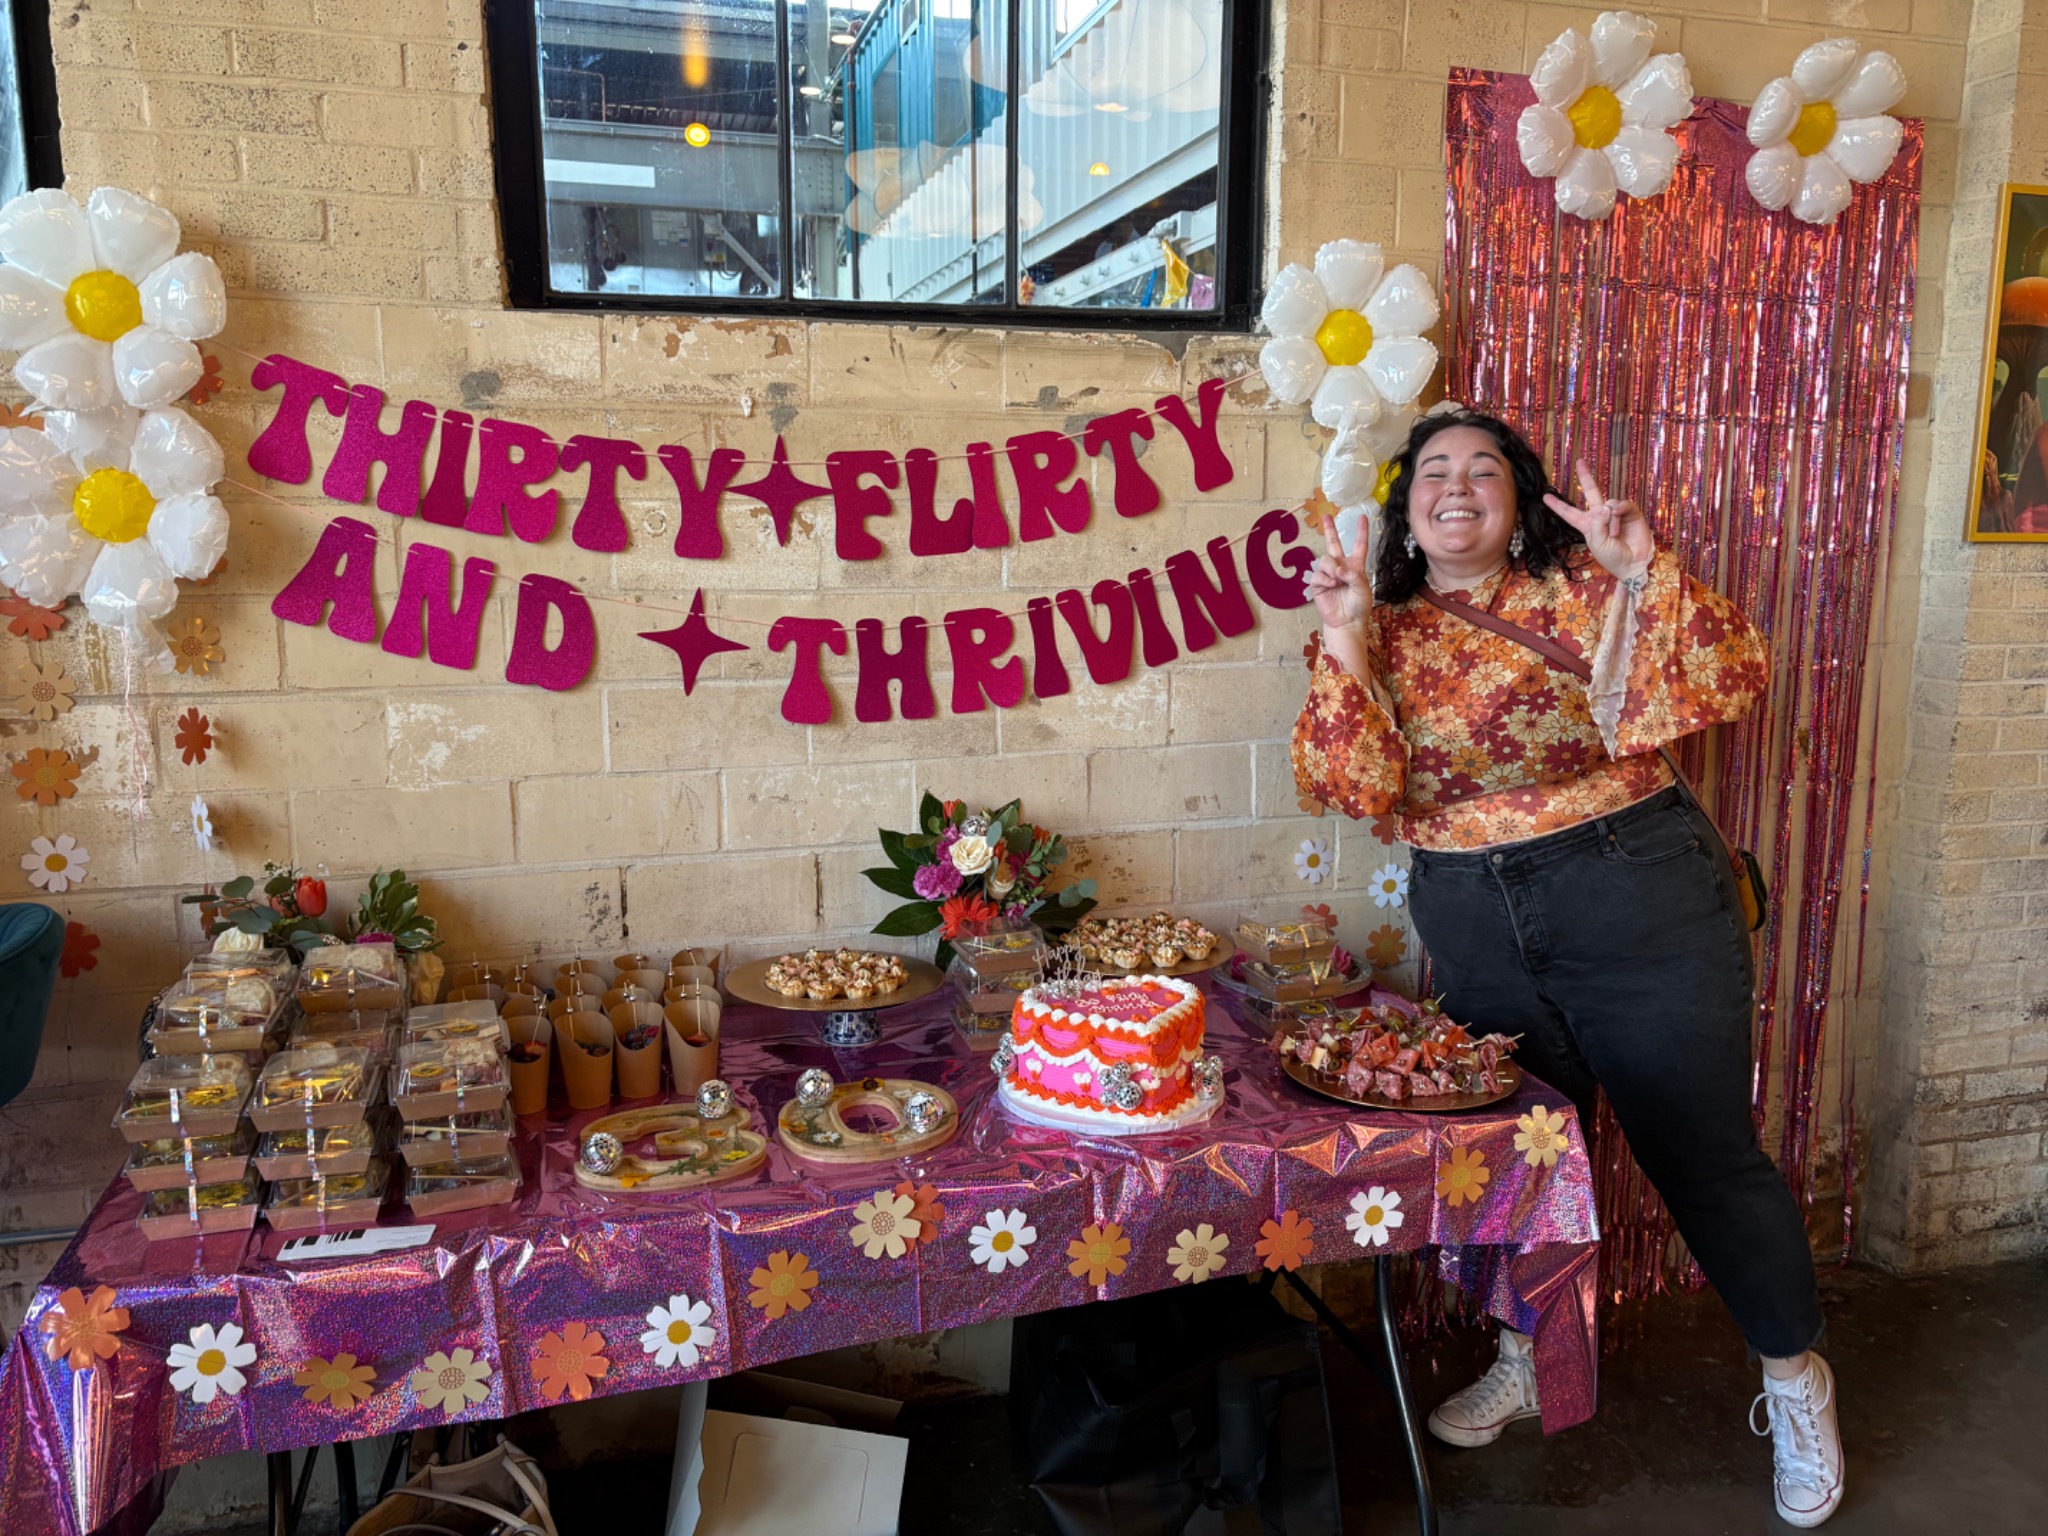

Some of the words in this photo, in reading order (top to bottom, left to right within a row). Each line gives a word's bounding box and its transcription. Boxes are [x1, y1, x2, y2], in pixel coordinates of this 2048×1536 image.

[248, 353, 745, 559] THIRTY
[826, 378, 1234, 561] FLIRTY
[271, 515, 595, 691] AND
[767, 508, 1316, 725] THRIVING
[1032, 937, 1085, 969] Happy
